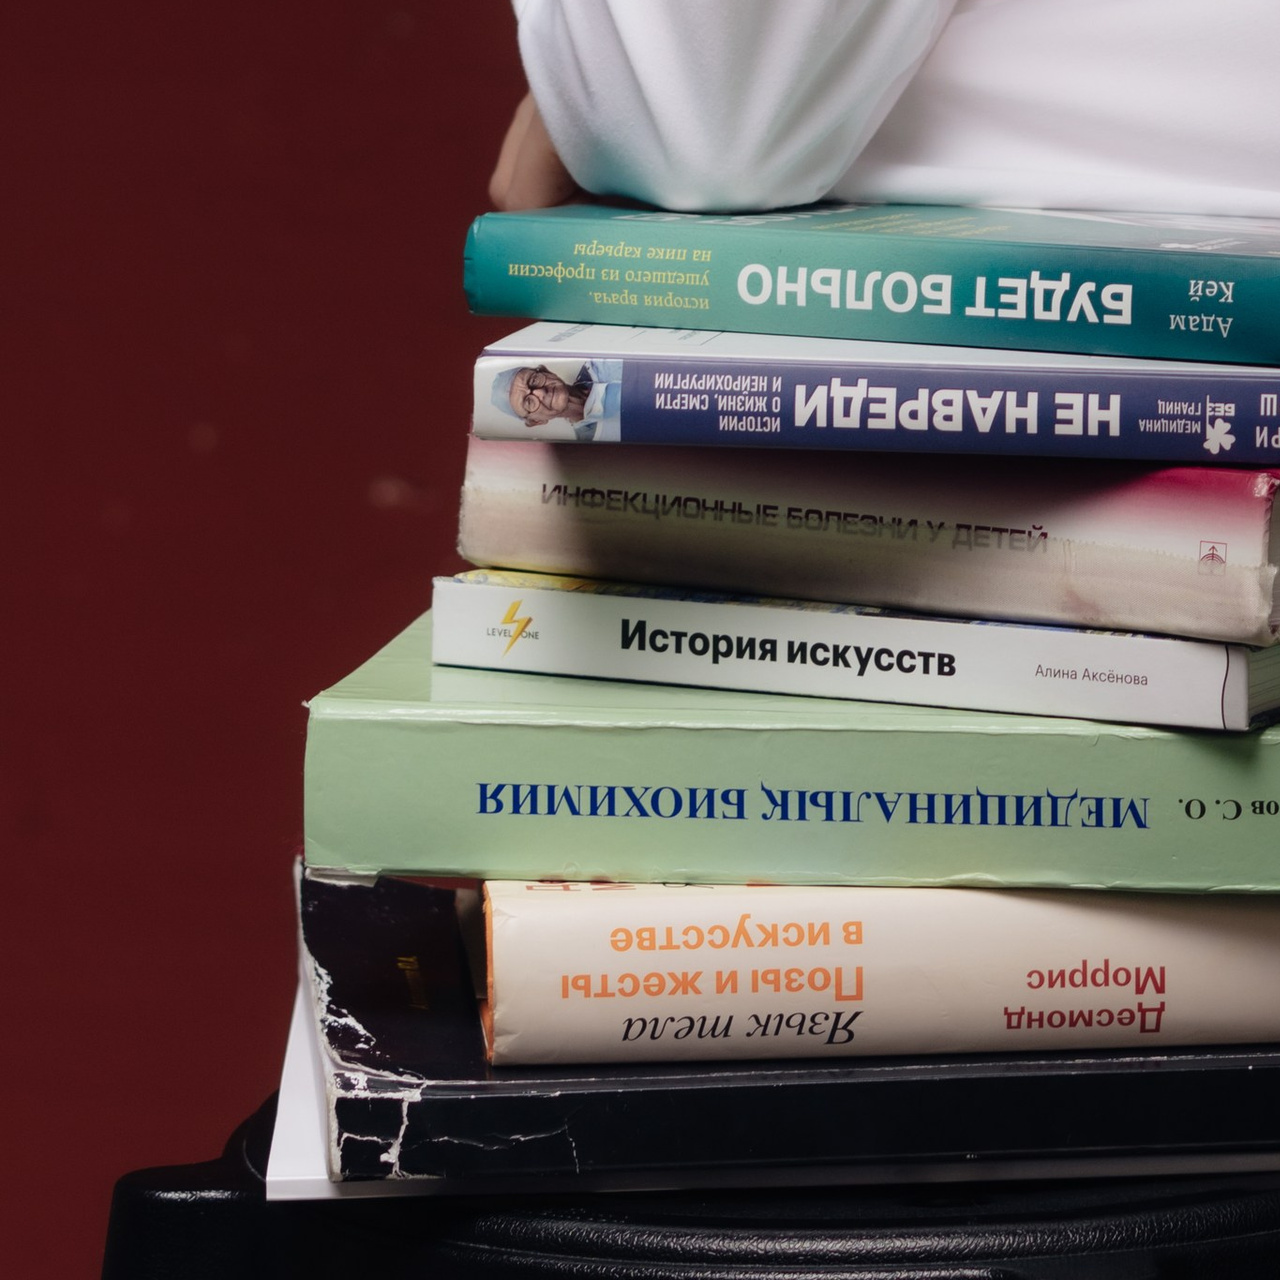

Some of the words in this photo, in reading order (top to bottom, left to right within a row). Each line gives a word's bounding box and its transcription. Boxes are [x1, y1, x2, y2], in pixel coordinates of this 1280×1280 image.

[573, 240, 642, 259] карьеры
[647, 247, 688, 261] пике
[694, 250, 712, 262] на
[508, 262, 597, 283] профессии
[600, 268, 621, 282] из
[625, 269, 710, 286] ушедшего
[737, 263, 952, 315] БОЛЬНО
[965, 271, 1133, 325] БУДЕТ
[1188, 279, 1235, 302] Кей
[644, 295, 710, 310] история
[1169, 314, 1233, 338] Адам
[654, 373, 767, 394] НЕЙРОХИРУРГИИ
[772, 376, 782, 392] И
[655, 393, 709, 410] СМЕРТИ
[713, 394, 768, 412] ЖИЗНИ,
[772, 397, 781, 413] О
[794, 377, 1039, 434] НАВРЕДИ
[1157, 399, 1201, 416] ГРАНИЦ
[1208, 403, 1235, 417] БЕЗ
[719, 415, 781, 433] ИСТОРИИ
[1054, 393, 1121, 436] НЕ
[1138, 418, 1201, 434] МЕДИЦИНА
[541, 483, 779, 527] ИНФЕКЦИОННЫЕ
[787, 507, 918, 540] БОЛЕЗНИ
[926, 520, 945, 543] У
[952, 523, 1048, 553] ДЕТЕЙ
[486, 627, 513, 639] LEVEL
[521, 631, 540, 640] ONE
[620, 618, 777, 664] История
[787, 641, 957, 677] искусств
[1035, 664, 1078, 681] Алина
[1081, 667, 1149, 686] Аксёнова
[475, 783, 749, 820] БИОХИМИЯ
[761, 781, 1151, 829] МЕДИЦИНАЛЫҚ
[1178, 798, 1206, 820] О.
[1215, 799, 1243, 821] С.
[610, 913, 829, 952] искусстве
[842, 921, 864, 944] в
[561, 970, 704, 999] жесты
[716, 970, 738, 993] и
[752, 966, 864, 1001] Позы
[1026, 958, 1166, 995] Моррис
[621, 1014, 734, 1042] тела
[746, 1010, 864, 1045] Язык
[1003, 1001, 1166, 1033] Десмонд
